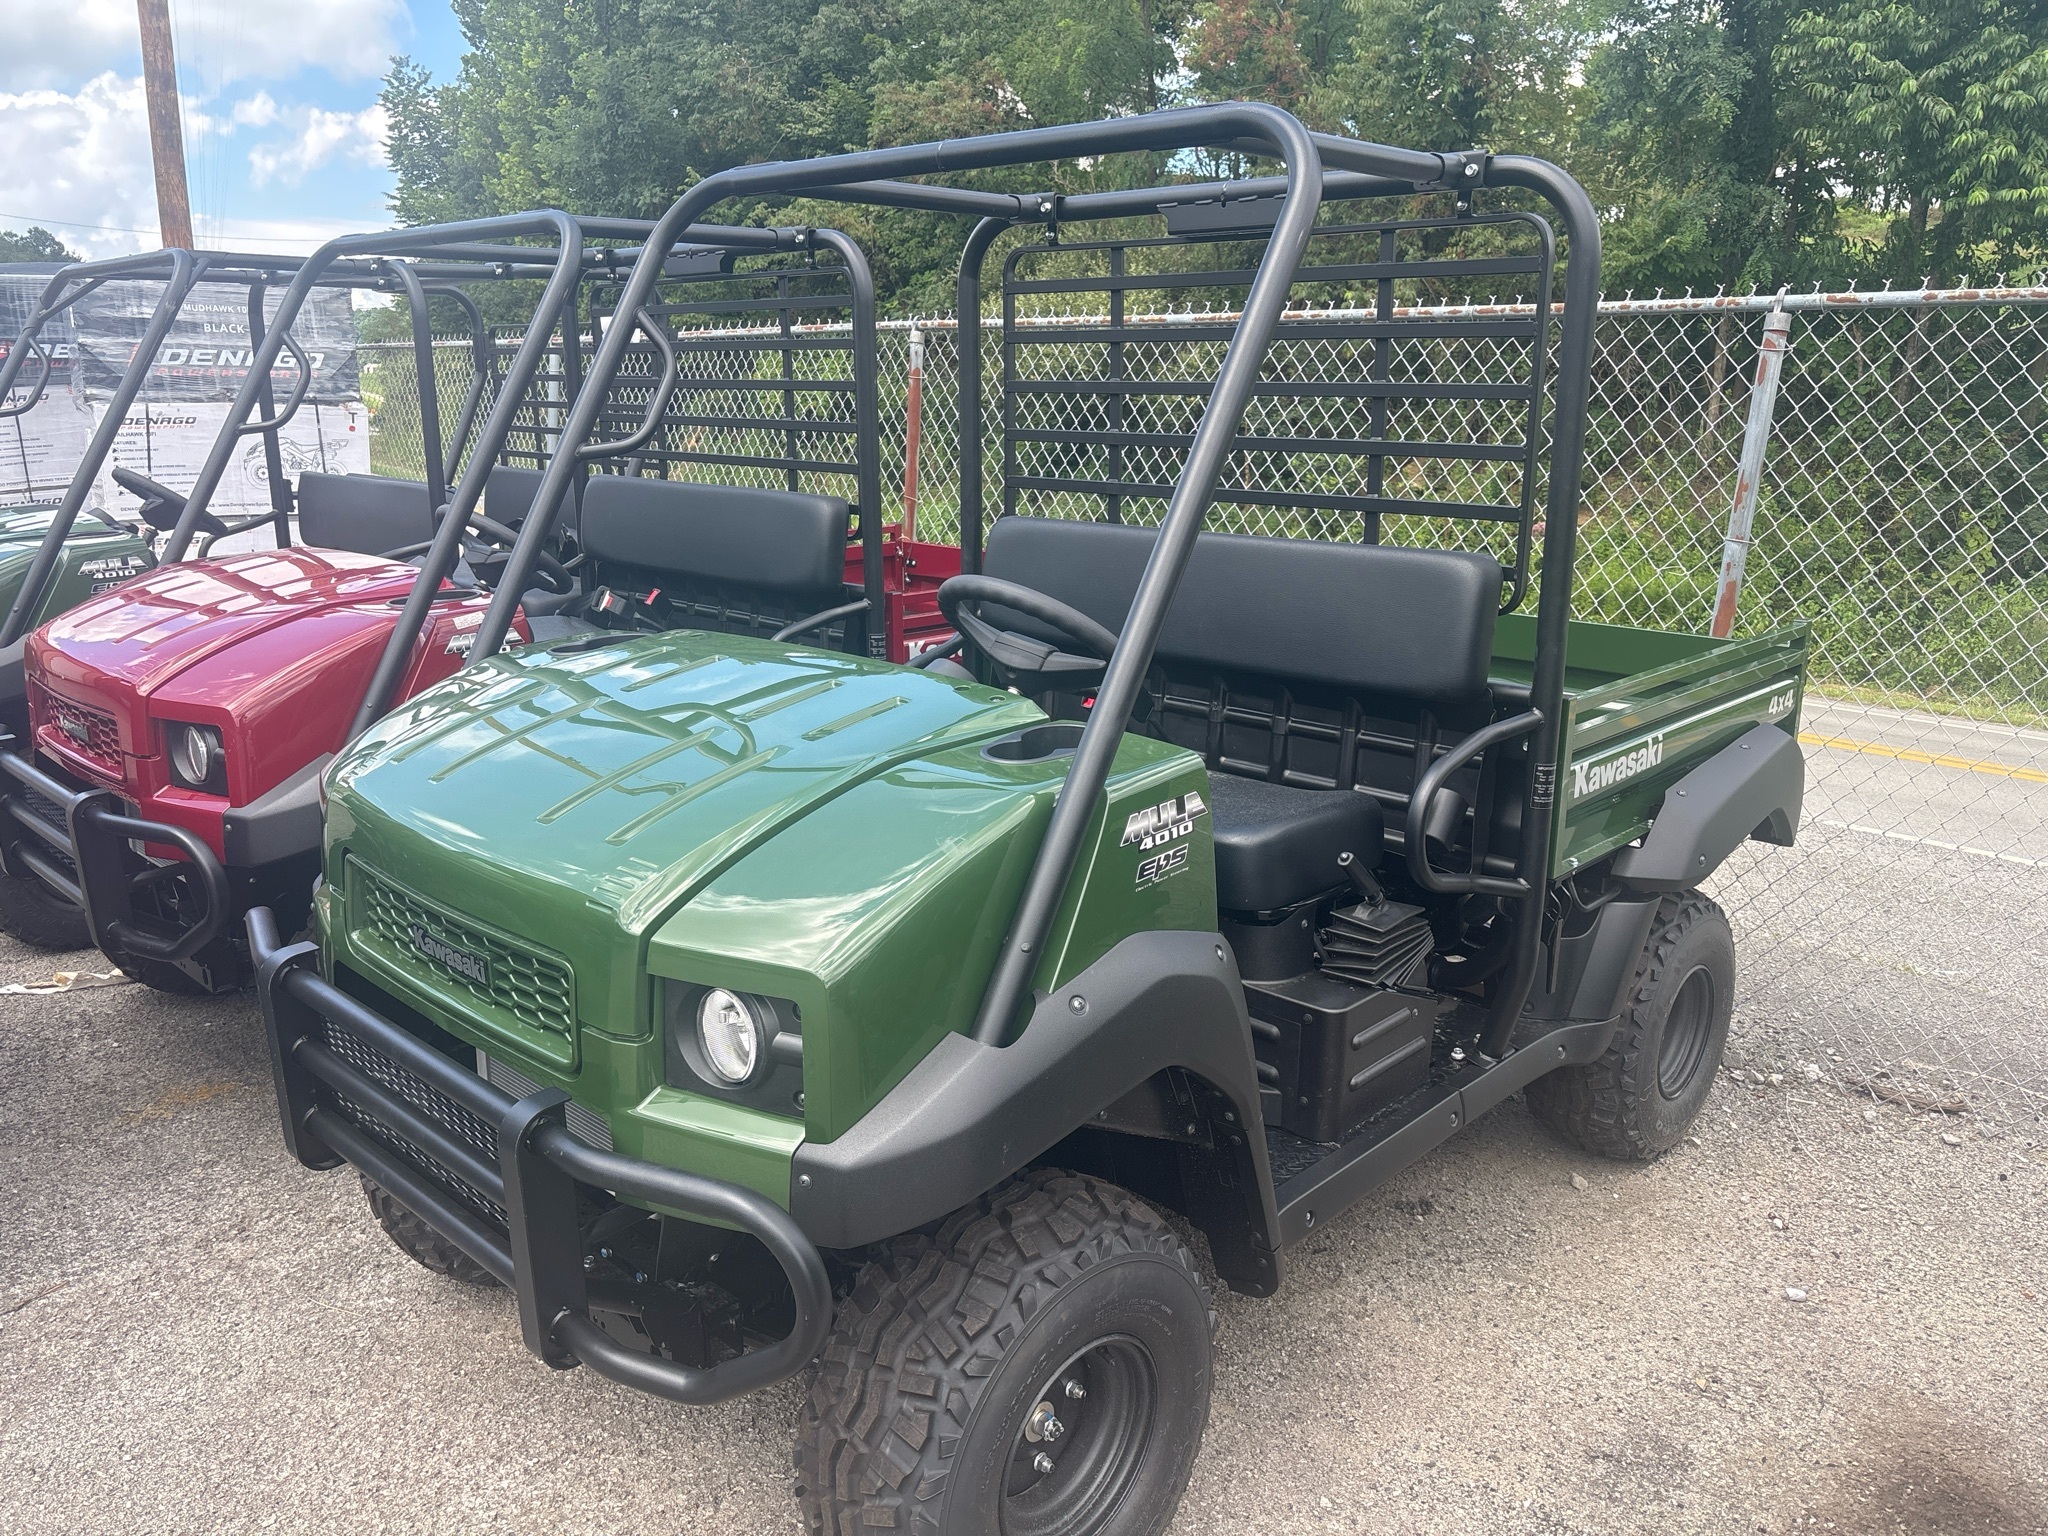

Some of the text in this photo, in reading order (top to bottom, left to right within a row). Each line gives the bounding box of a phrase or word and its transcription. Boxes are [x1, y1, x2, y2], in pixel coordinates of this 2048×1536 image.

[183, 303, 234, 313] MUDHAWK
[203, 322, 245, 334] BLACK
[121, 416, 197, 426] DENAGO
[78, 556, 148, 575] MULE
[93, 569, 136, 578] 4010
[1768, 688, 1794, 715] 4x4
[1573, 733, 1664, 799] Kawasaki
[1119, 790, 1209, 848] MULE
[1139, 820, 1193, 852] 4010
[1135, 842, 1189, 884] EPS
[412, 925, 487, 985] Kawasaki
